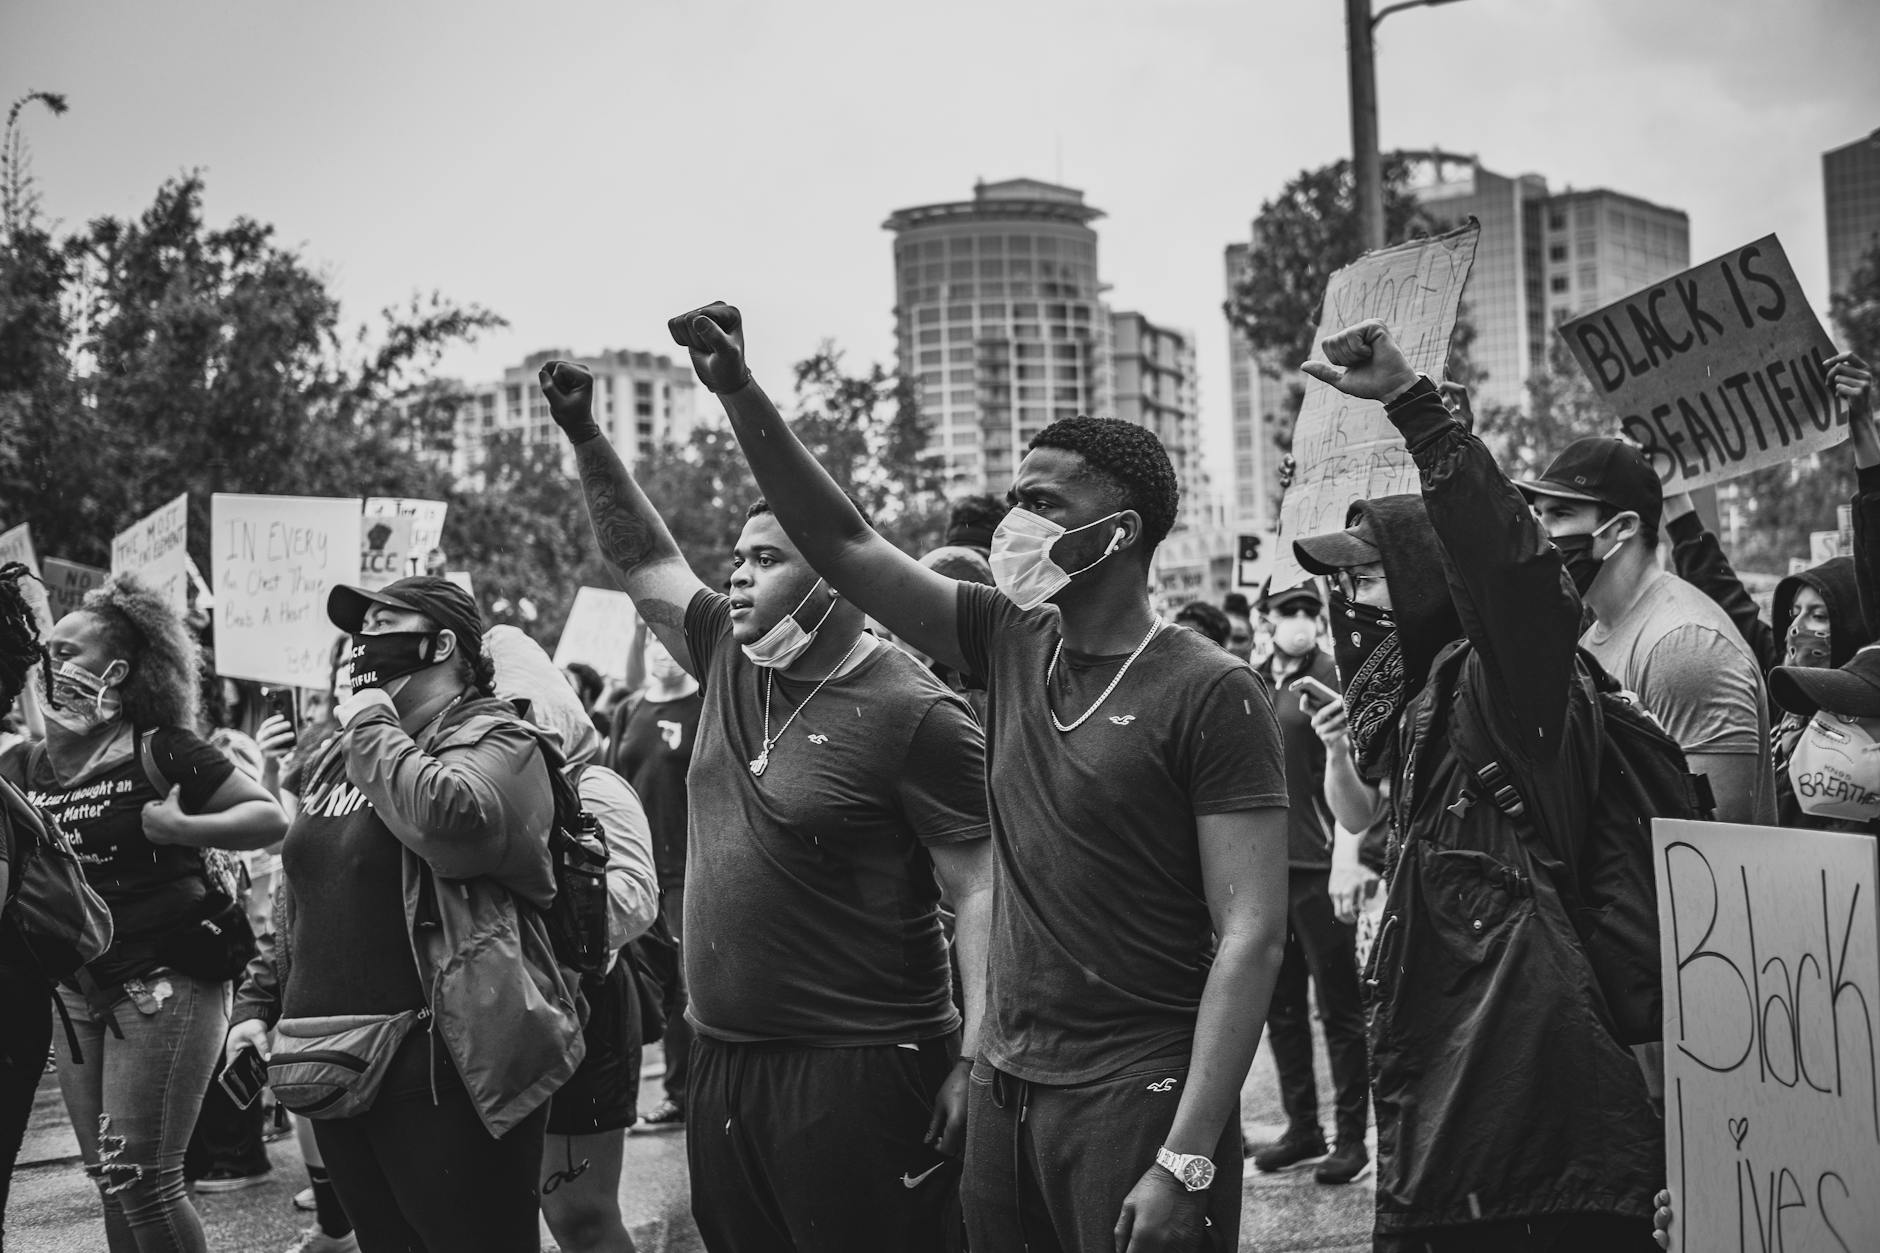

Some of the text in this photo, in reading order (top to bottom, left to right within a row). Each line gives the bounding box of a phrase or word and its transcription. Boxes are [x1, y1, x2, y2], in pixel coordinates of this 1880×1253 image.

[1576, 246, 1786, 393] BLACK IS
[225, 517, 257, 563] IN
[65, 570, 92, 589] NO
[1798, 771, 1880, 806] BREATHE
[1665, 841, 1880, 1145] Black
